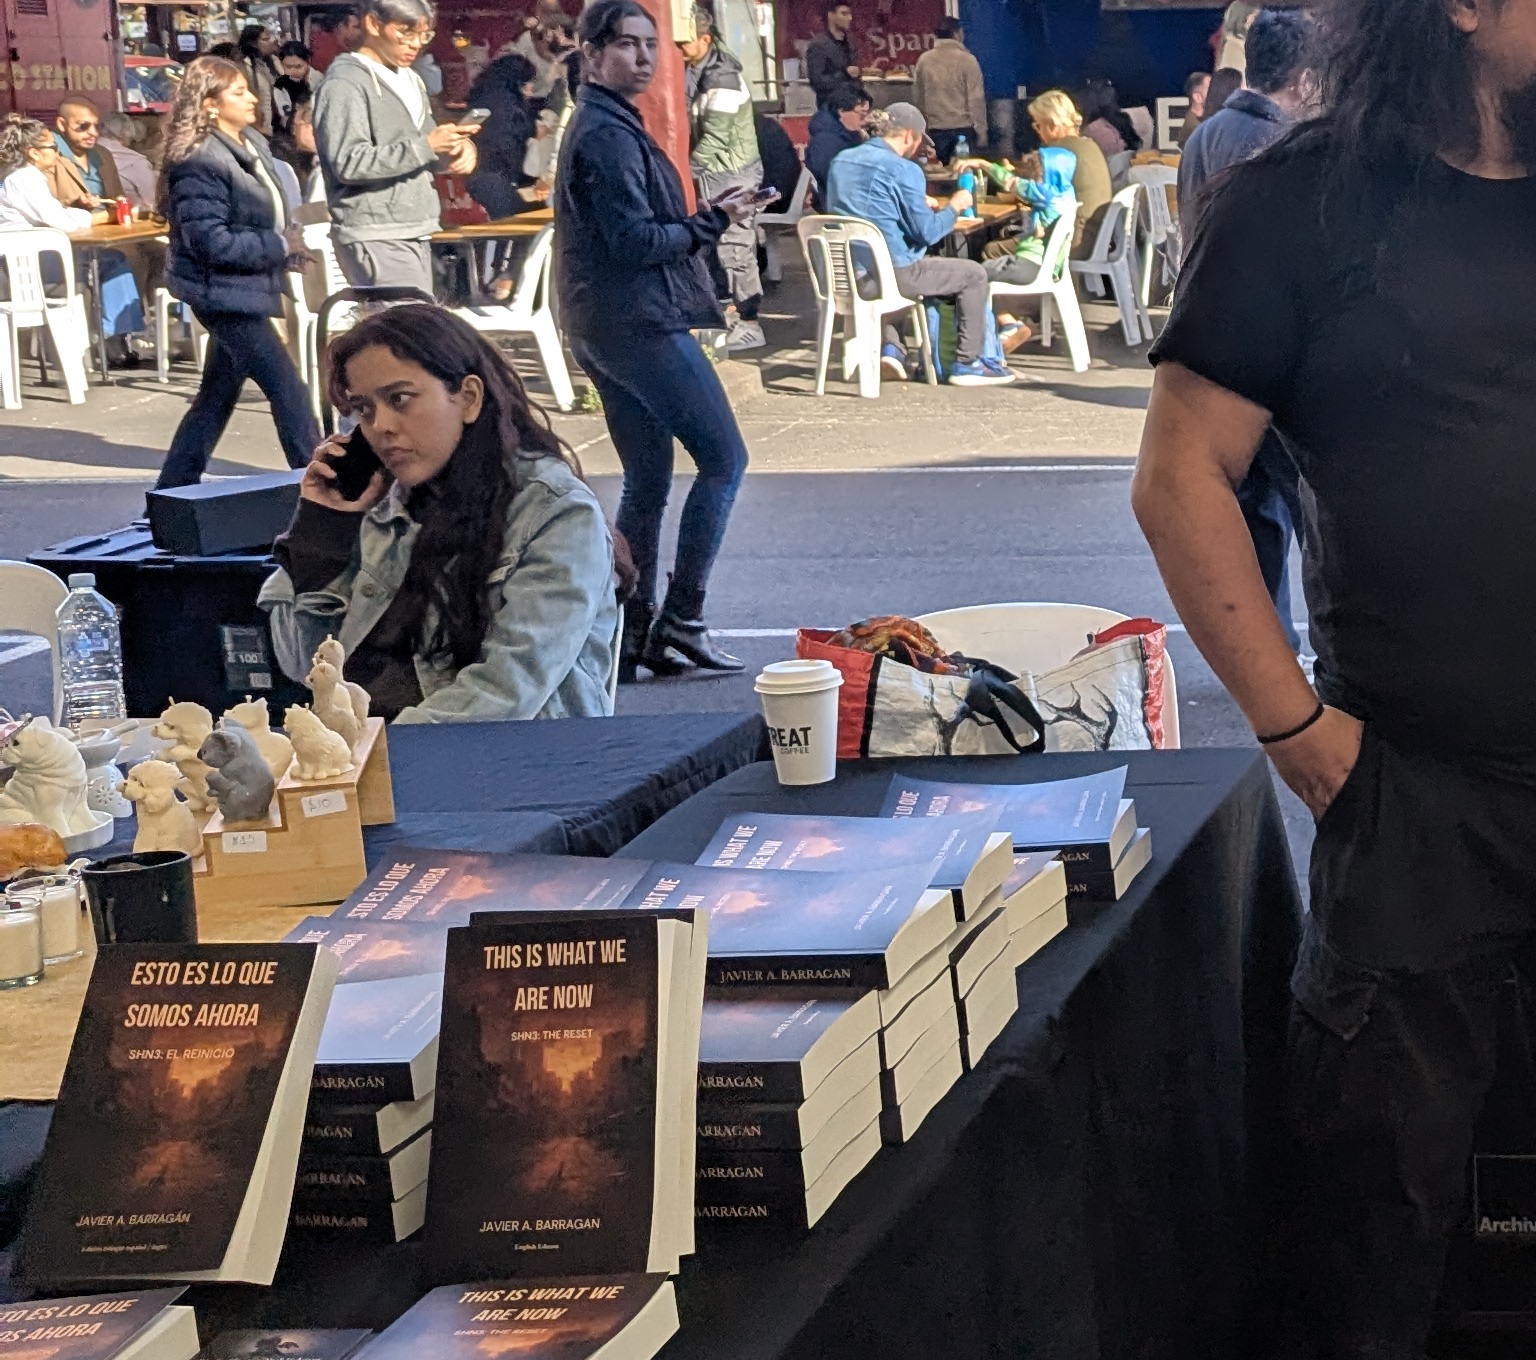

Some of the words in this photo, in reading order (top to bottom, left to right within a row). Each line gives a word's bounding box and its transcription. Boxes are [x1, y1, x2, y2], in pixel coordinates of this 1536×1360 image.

[31, 64, 112, 91] STATION
[780, 747, 810, 755] COFFEE
[484, 944, 523, 970] THIS
[526, 943, 543, 968] IS
[546, 940, 597, 967] WHAT
[600, 938, 627, 964] WE
[131, 961, 180, 986] ESTO
[182, 961, 209, 986] ES
[210, 961, 237, 986] LO
[238, 961, 279, 986] QUE
[720, 970, 764, 984] JAVIER
[781, 968, 851, 981] BARRAGAN
[514, 986, 549, 1011] ARE
[553, 984, 594, 1011] NOW
[124, 1004, 192, 1028] SOMOS
[194, 1003, 260, 1028] AHORA
[511, 1031, 541, 1042] SHN3:
[543, 1030, 562, 1040] THE
[564, 1028, 594, 1040] RESET
[128, 1049, 164, 1061] SHN3:
[166, 1048, 180, 1060] EL
[183, 1048, 236, 1060] REINICIO
[76, 1215, 115, 1227] JAVIER
[479, 1220, 519, 1233] JAVIER
[521, 1220, 533, 1231] A.
[535, 1218, 600, 1231] BARRAGAN
[458, 1289, 506, 1304] THIS
[504, 1288, 529, 1302] IS
[528, 1286, 590, 1301] WHAT
[589, 1286, 625, 1300] WE
[25, 1306, 60, 1321] ES
[56, 1303, 91, 1319] LO
[88, 1298, 139, 1316] QUE
[471, 1308, 518, 1322] ARE
[514, 1307, 569, 1321] NOW
[24, 1322, 104, 1341] AHORA
